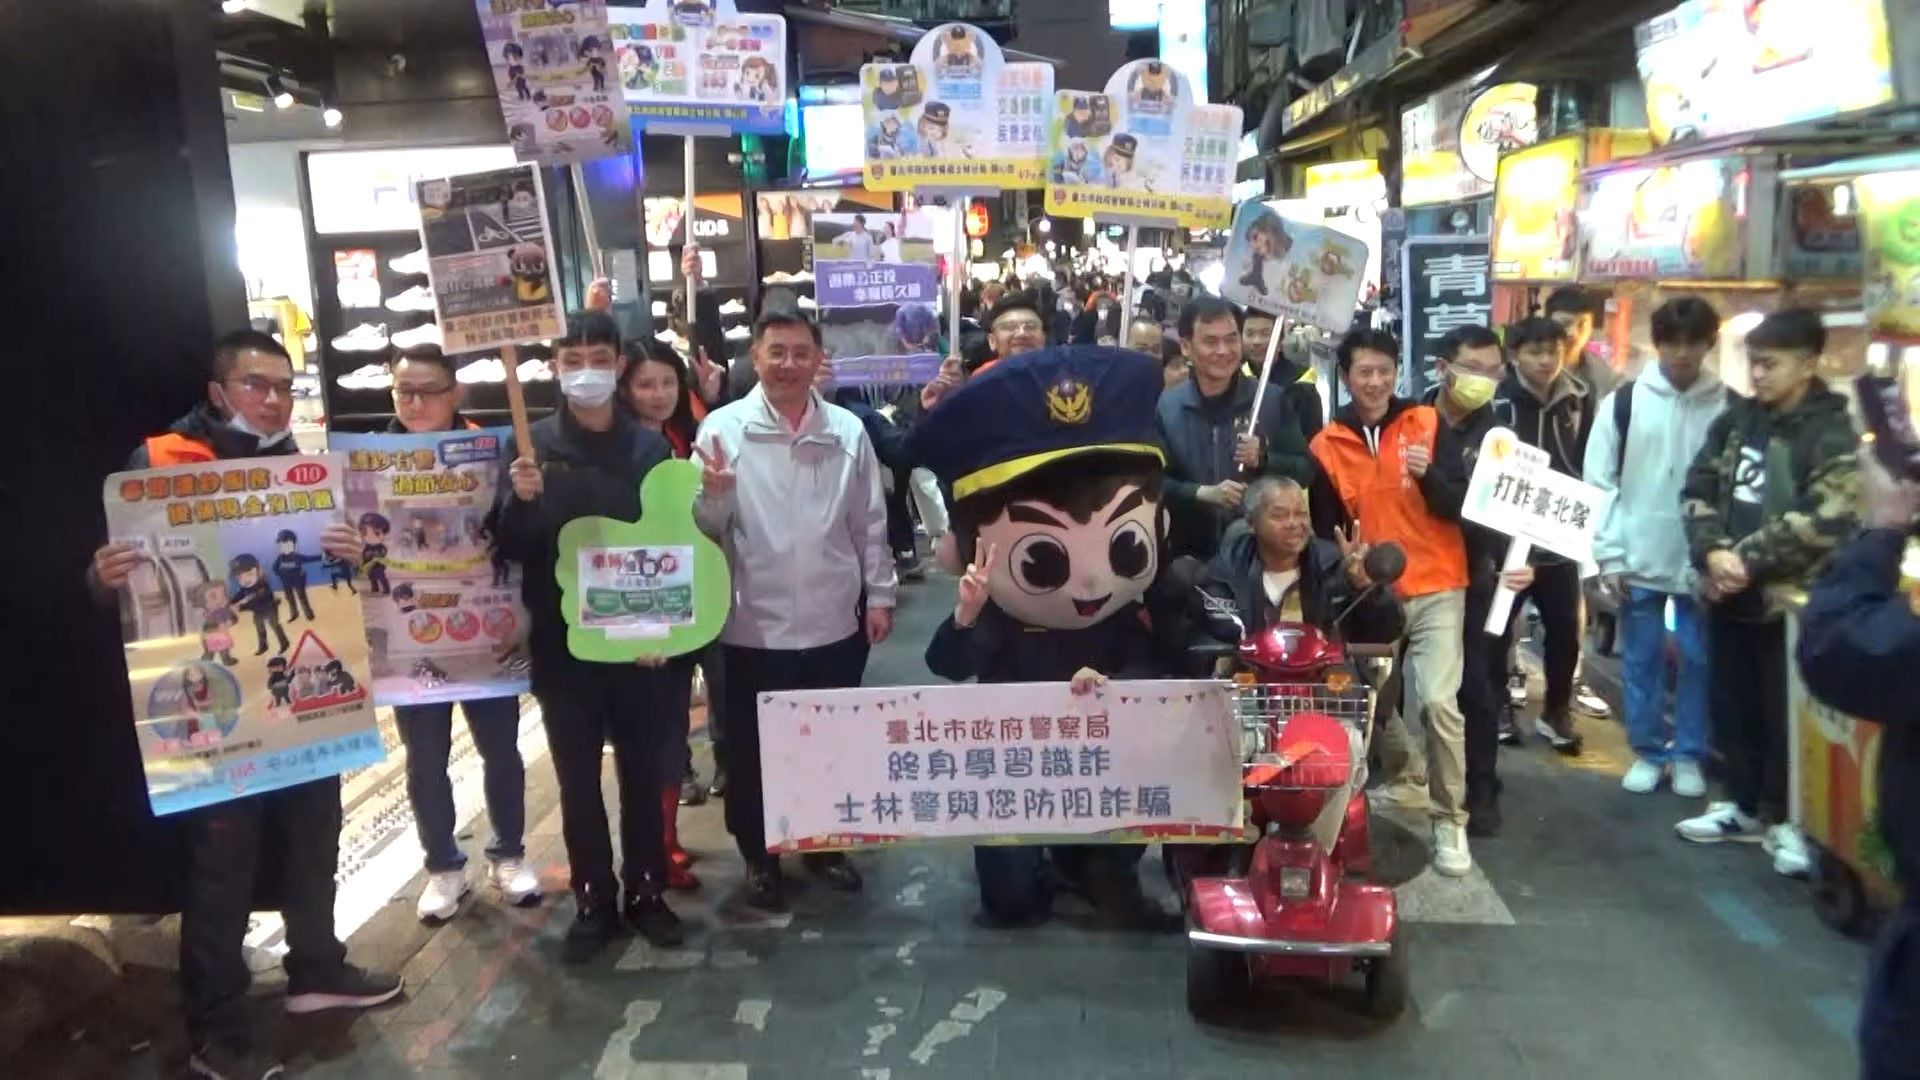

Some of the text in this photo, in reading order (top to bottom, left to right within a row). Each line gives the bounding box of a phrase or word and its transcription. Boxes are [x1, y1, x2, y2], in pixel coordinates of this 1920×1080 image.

[295, 466, 321, 484] 110
[886, 714, 1110, 745] 臺北市政府警察局
[888, 745, 1110, 781] 終身學習識詐
[834, 784, 1172, 824] 士林警與您防阻詐騙
